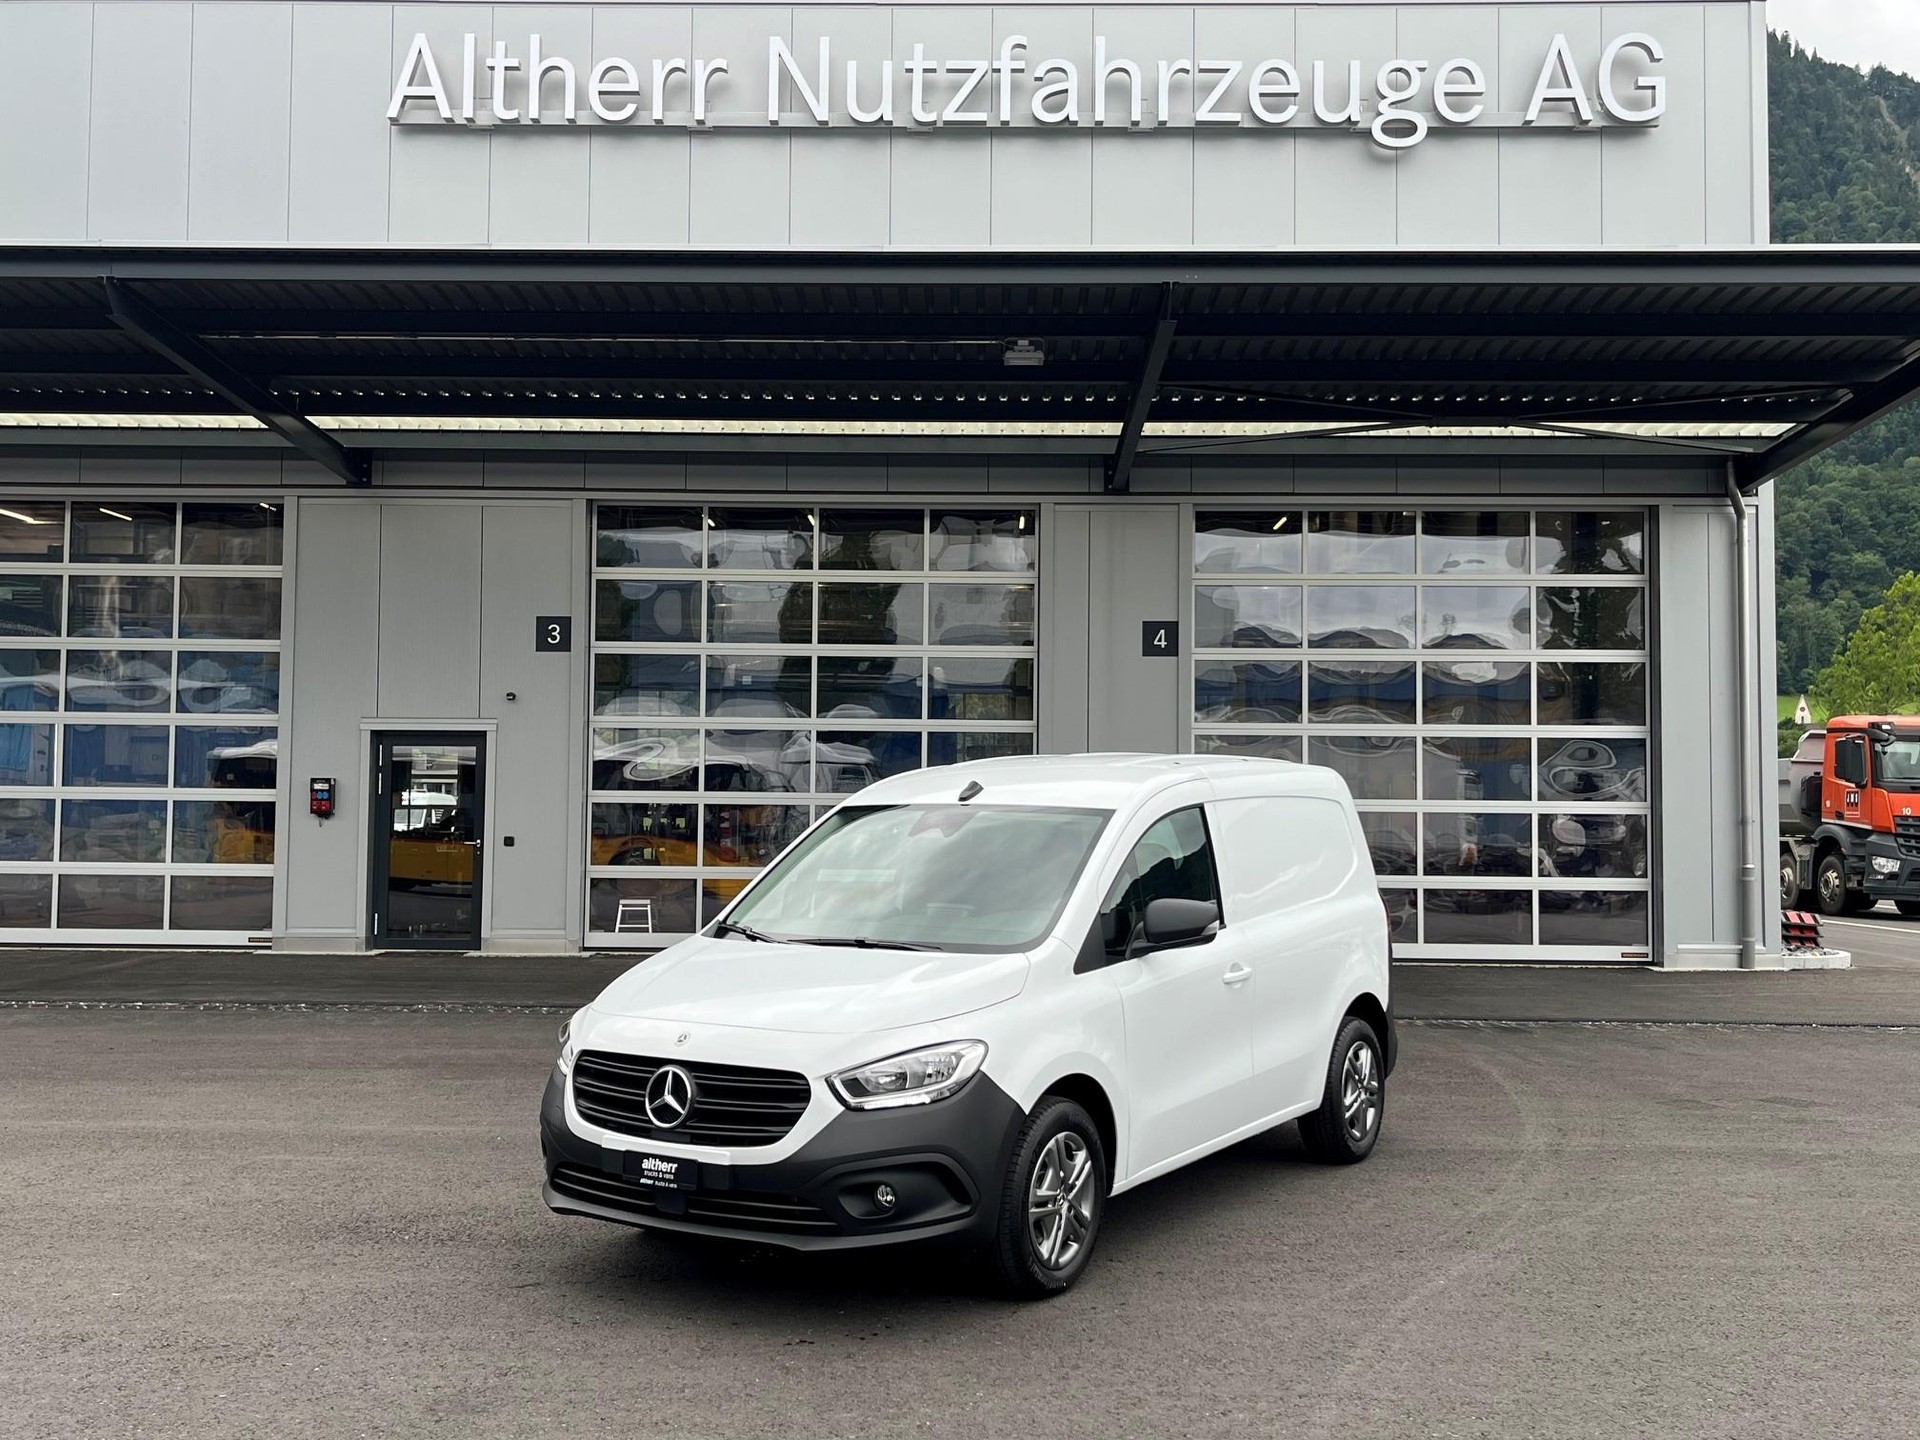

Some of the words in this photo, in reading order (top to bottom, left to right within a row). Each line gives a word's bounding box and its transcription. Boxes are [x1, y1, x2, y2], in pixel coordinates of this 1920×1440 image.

[387, 32, 729, 124] Altherr
[767, 34, 1487, 149] Nutzfahrzeuge
[1523, 32, 1667, 126] AG
[547, 624, 560, 644] 3
[1153, 629, 1168, 649] 4
[1901, 807, 1912, 816] 10
[641, 1157, 678, 1173] altherr
